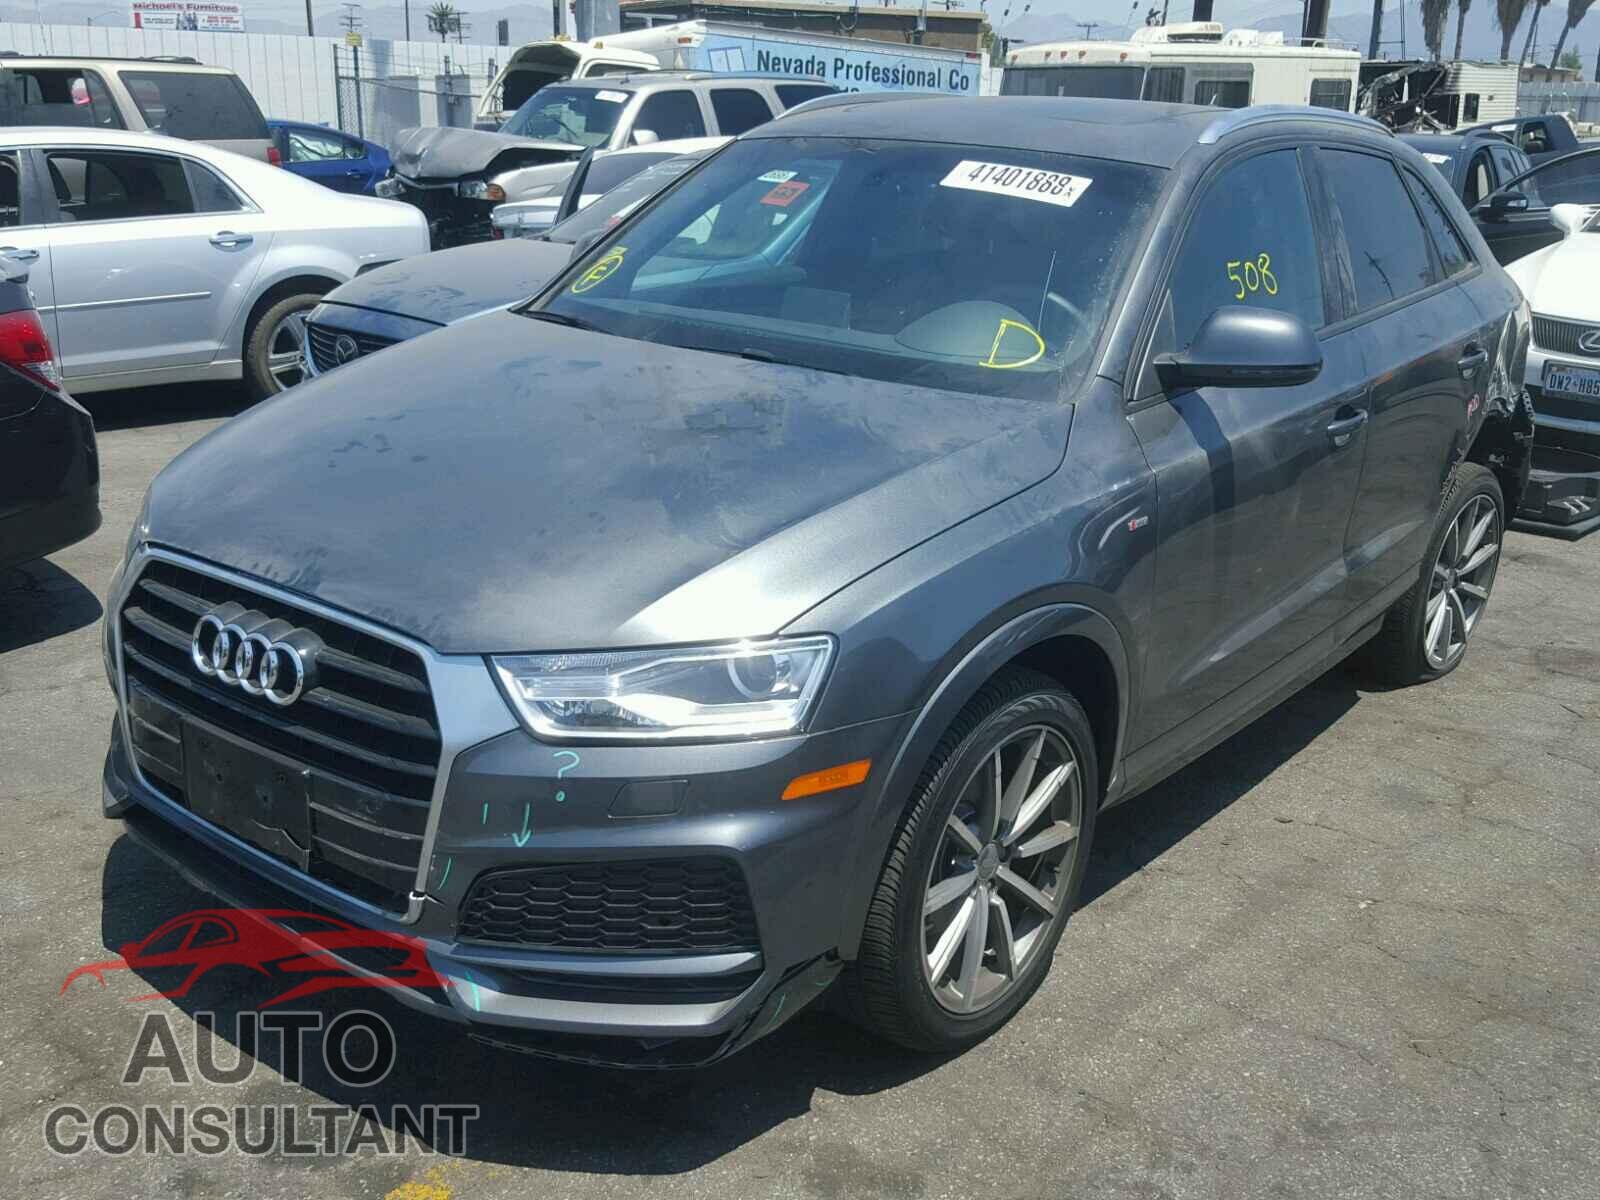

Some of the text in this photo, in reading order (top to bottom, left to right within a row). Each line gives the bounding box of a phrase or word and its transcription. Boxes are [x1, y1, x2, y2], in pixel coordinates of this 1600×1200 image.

[186, 3, 240, 13] Furniture
[757, 50, 970, 91] Nevada Professional Co
[1226, 252, 1278, 301] 508
[979, 318, 1046, 369] D
